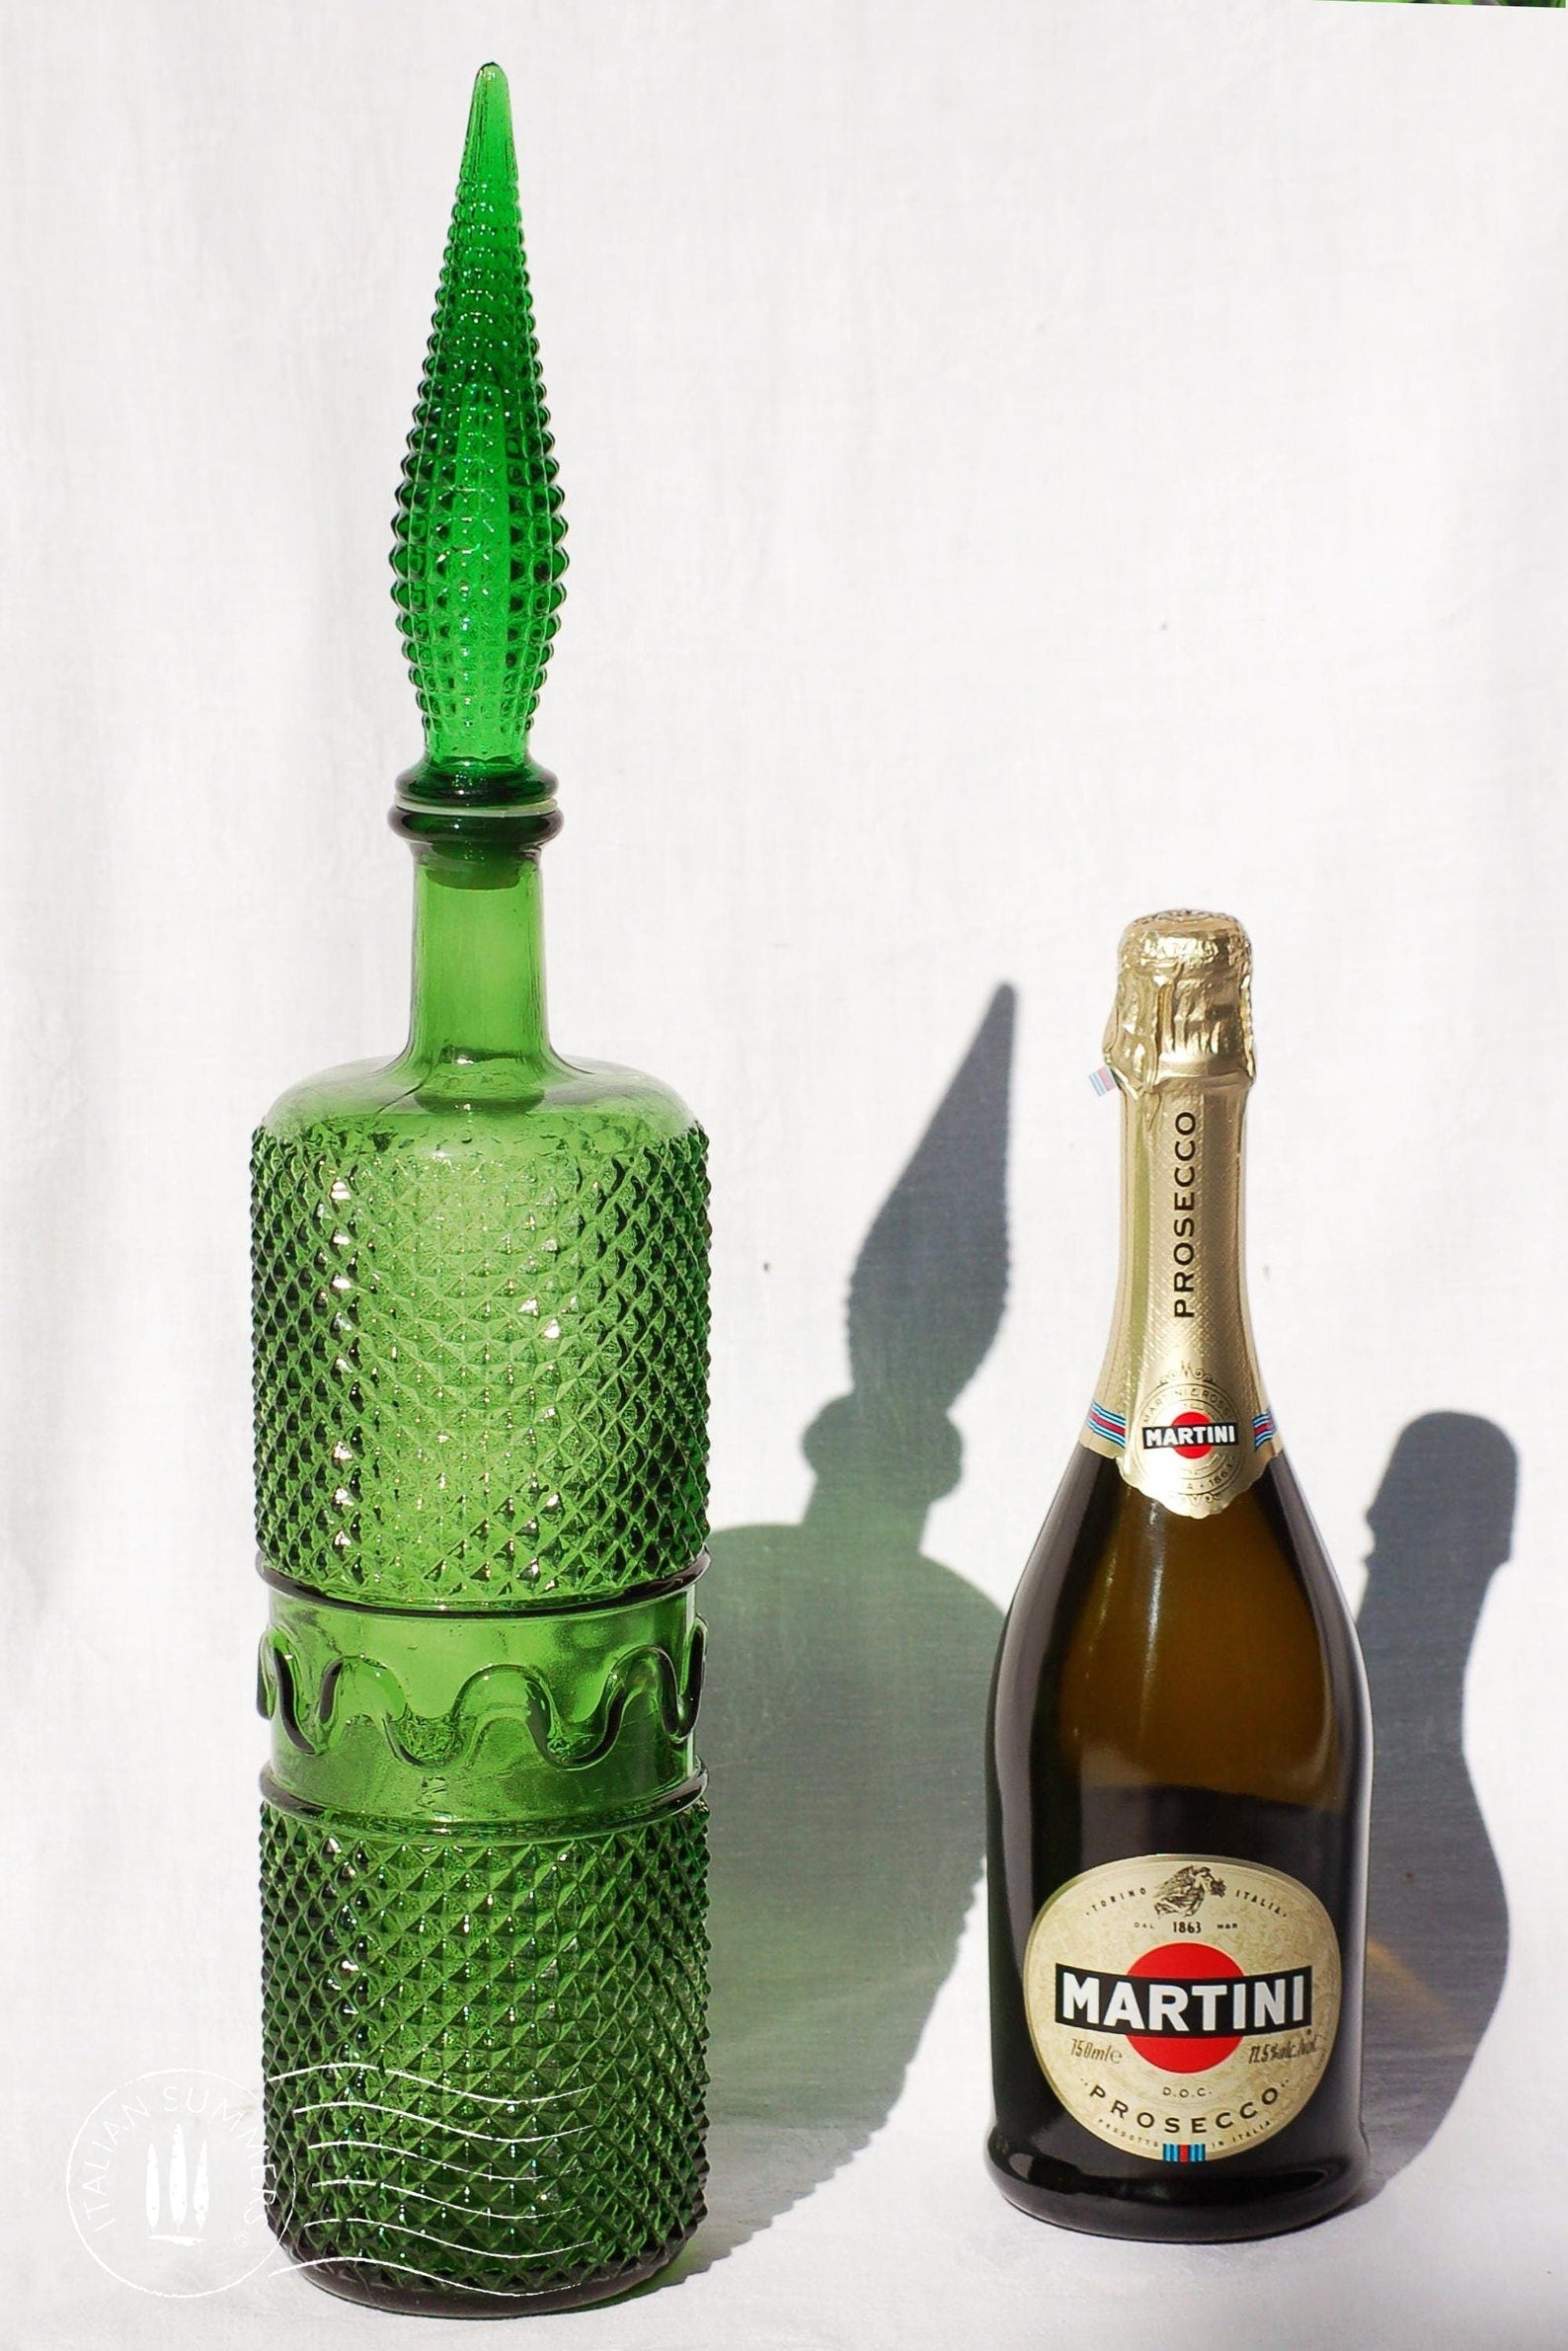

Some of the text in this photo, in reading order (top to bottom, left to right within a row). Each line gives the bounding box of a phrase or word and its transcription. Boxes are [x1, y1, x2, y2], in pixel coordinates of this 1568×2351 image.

[1173, 1111, 1197, 1318] PROSECCO
[1145, 1425, 1235, 1448] MARTINI
[1091, 1887, 1281, 1916] TORINO ITALIA
[1172, 1921, 1202, 1934] 1863
[1062, 1971, 1304, 2032] MARTINI
[1162, 2086, 1213, 2098] D.O.C.
[1089, 2084, 1280, 2134] PROSECCO
[1232, 2120, 1271, 2143] ITALIA
